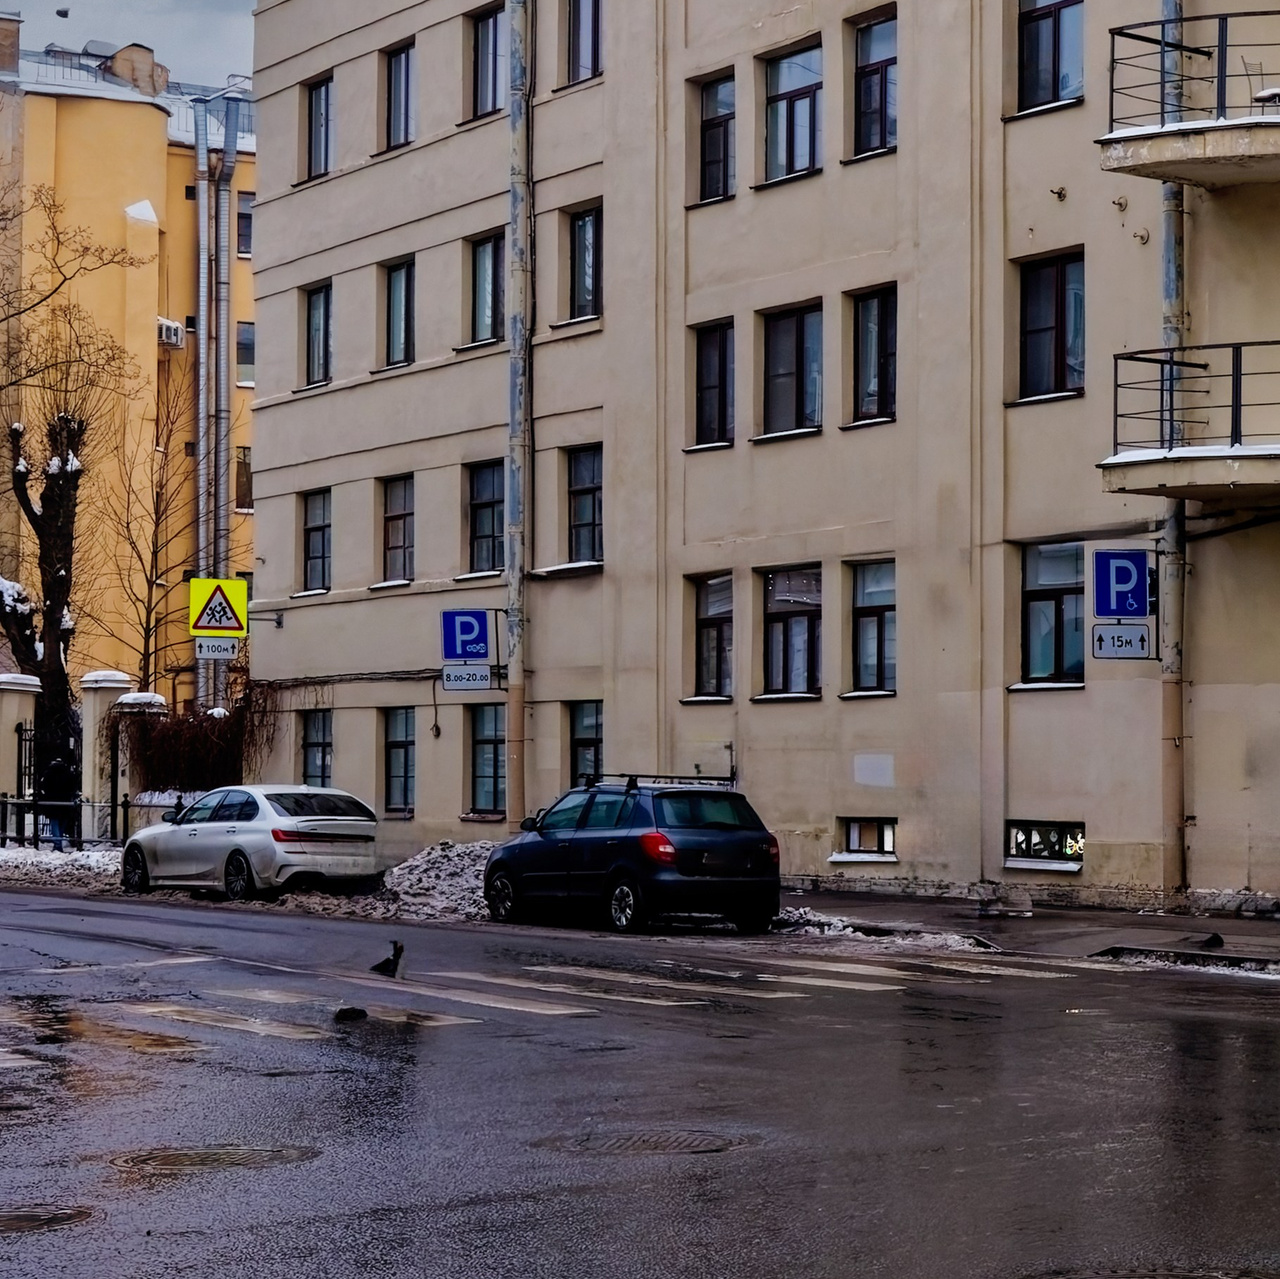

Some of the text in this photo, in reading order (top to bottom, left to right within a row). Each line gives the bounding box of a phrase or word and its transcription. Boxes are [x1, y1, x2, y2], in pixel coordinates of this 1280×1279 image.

[1110, 559, 1138, 610] P
[455, 616, 480, 654] P
[1110, 635, 1133, 648] 15м
[206, 644, 229, 653] 100м
[445, 673, 489, 682] 8.00-20.00
